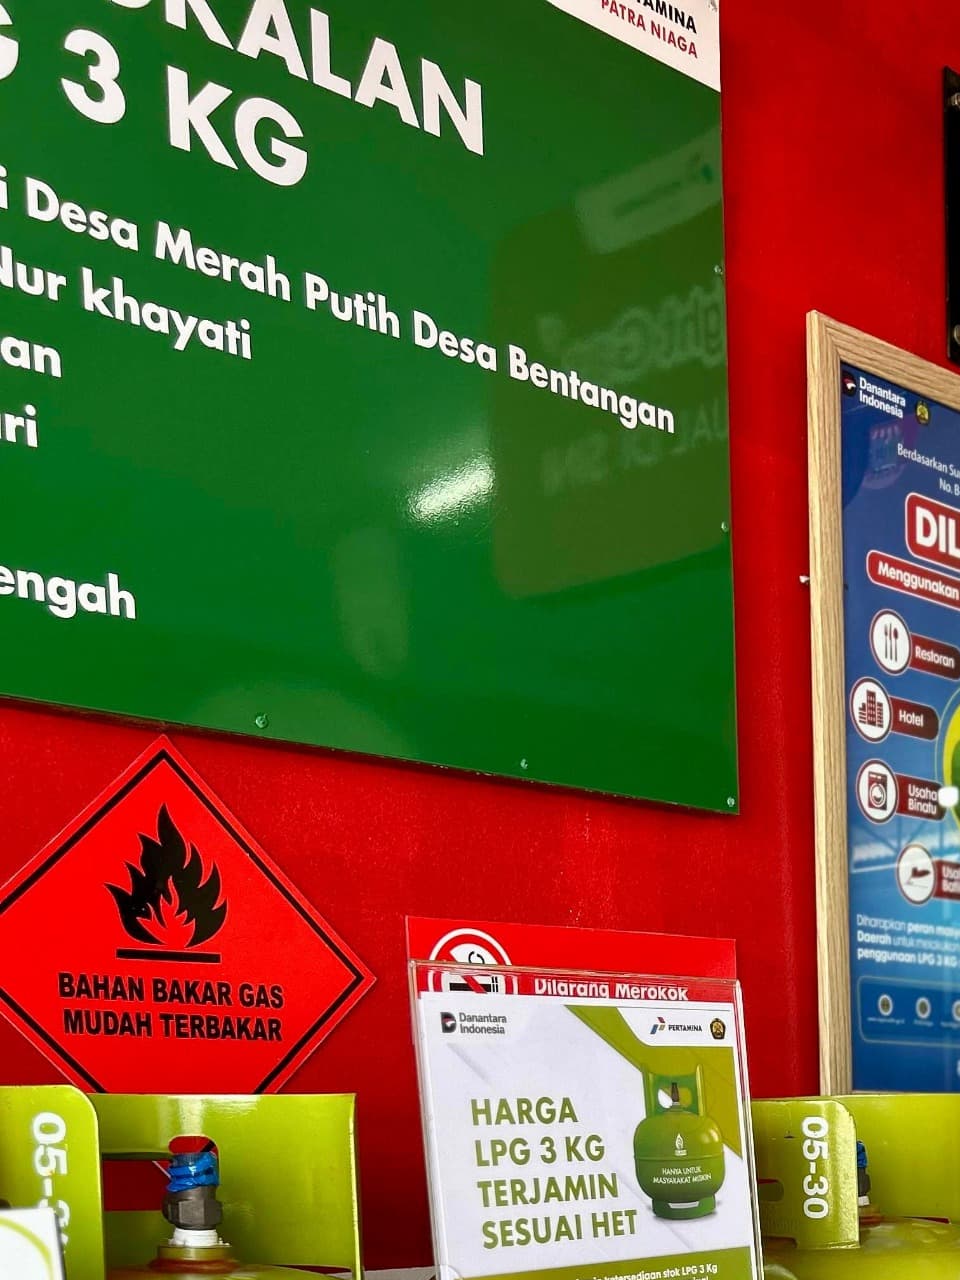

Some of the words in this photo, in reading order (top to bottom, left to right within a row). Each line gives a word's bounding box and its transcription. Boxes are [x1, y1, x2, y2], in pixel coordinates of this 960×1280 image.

[650, 20, 698, 59] NIAGA
[61, 28, 126, 124] 3
[166, 64, 308, 187] KG
[26, 176, 139, 251] Desa
[155, 221, 291, 301] Merah
[304, 271, 400, 339] Putih
[413, 310, 497, 371] Desa
[508, 344, 675, 434] Bentangan
[82, 267, 252, 360] khayati
[859, 376, 906, 407] Danantara
[859, 390, 904, 419] Indonesia
[897, 443, 948, 475] Berdasarkan
[939, 477, 953, 495] No.
[878, 560, 960, 602] Menggunakan
[915, 646, 955, 669] Restoran
[899, 709, 924, 727] Hotel
[908, 797, 937, 815] Binatu
[856, 914, 905, 934] Diharapkan
[907, 922, 934, 936] peran
[857, 930, 891, 946] Daerah
[857, 947, 916, 966] penggunaan
[58, 973, 144, 1003] BAHAN
[152, 977, 231, 1007] BAKAR
[239, 982, 283, 1009] GAS
[534, 978, 609, 999] Dilarang
[615, 983, 688, 1001] Merokok
[63, 1008, 152, 1038] MUDAH
[159, 1013, 282, 1042] TERBAKAR
[459, 1012, 507, 1026] Danantara
[460, 1024, 506, 1035] Indonesia
[668, 1023, 703, 1033] PERTAMINA
[471, 1096, 579, 1126] HARGA
[475, 1138, 531, 1167] LPG
[540, 1136, 556, 1164] 3
[566, 1134, 606, 1162] KG
[801, 1115, 829, 1220] 05-30
[477, 1172, 619, 1208] TERJAMIN
[482, 1214, 583, 1250] SESUAI
[592, 1208, 638, 1239] HET
[663, 1267, 680, 1279] stok
[682, 1265, 697, 1277] LPG
[699, 1264, 705, 1275] 3
[706, 1263, 718, 1275] Kg
